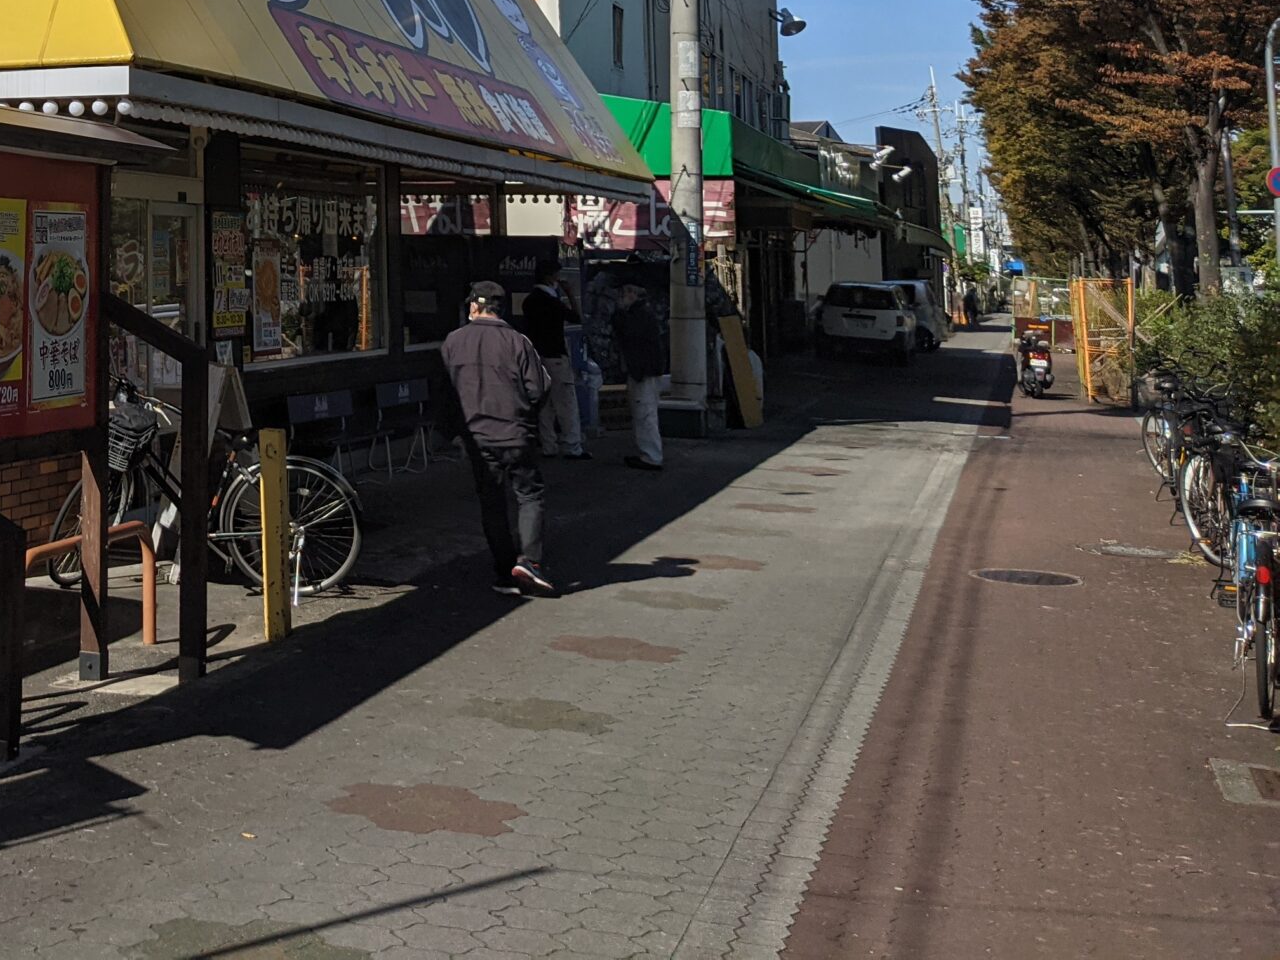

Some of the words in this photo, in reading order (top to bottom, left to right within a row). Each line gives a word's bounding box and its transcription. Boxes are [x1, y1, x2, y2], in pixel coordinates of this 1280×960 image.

[298, 24, 437, 113] キムチバー
[39, 337, 80, 369] 中華そば
[48, 368, 73, 391] 800円
